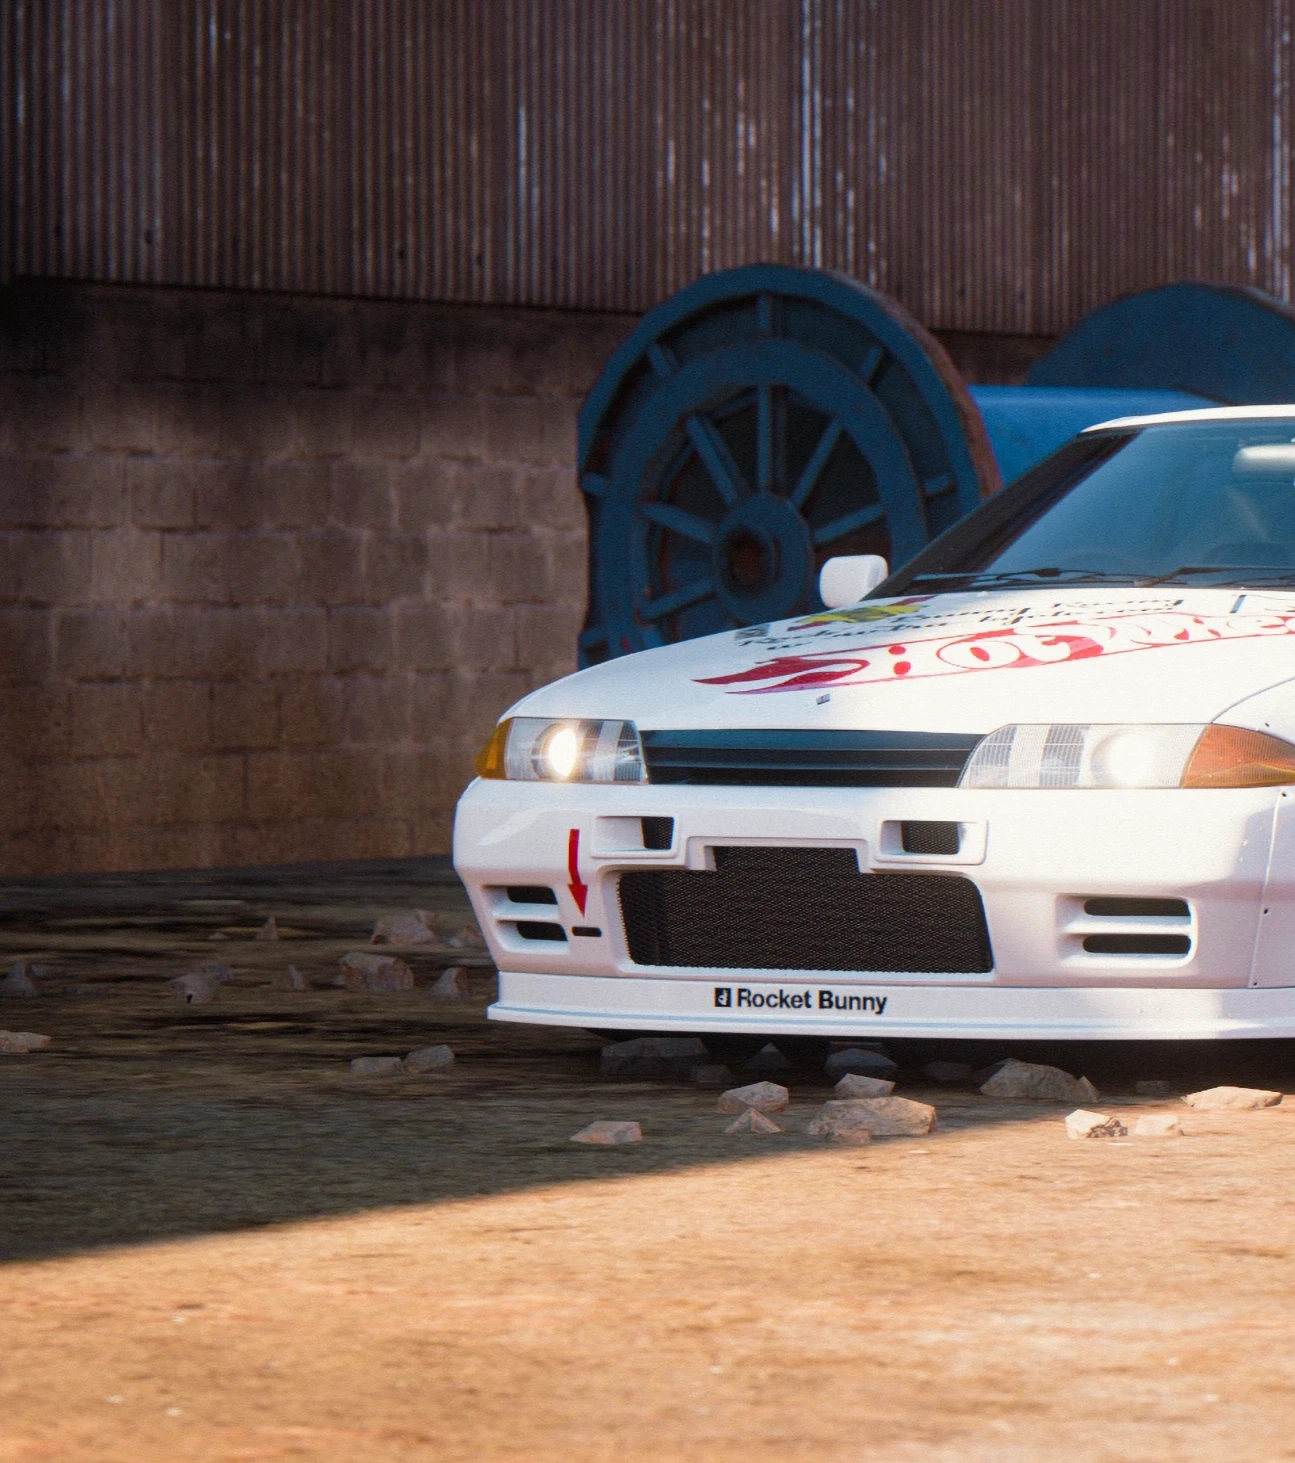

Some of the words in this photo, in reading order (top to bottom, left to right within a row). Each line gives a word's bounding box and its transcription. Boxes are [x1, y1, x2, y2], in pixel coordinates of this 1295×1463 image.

[888, 607, 1031, 624] Bunny
[737, 988, 812, 1009] Rocket
[818, 990, 887, 1015] Bunny
